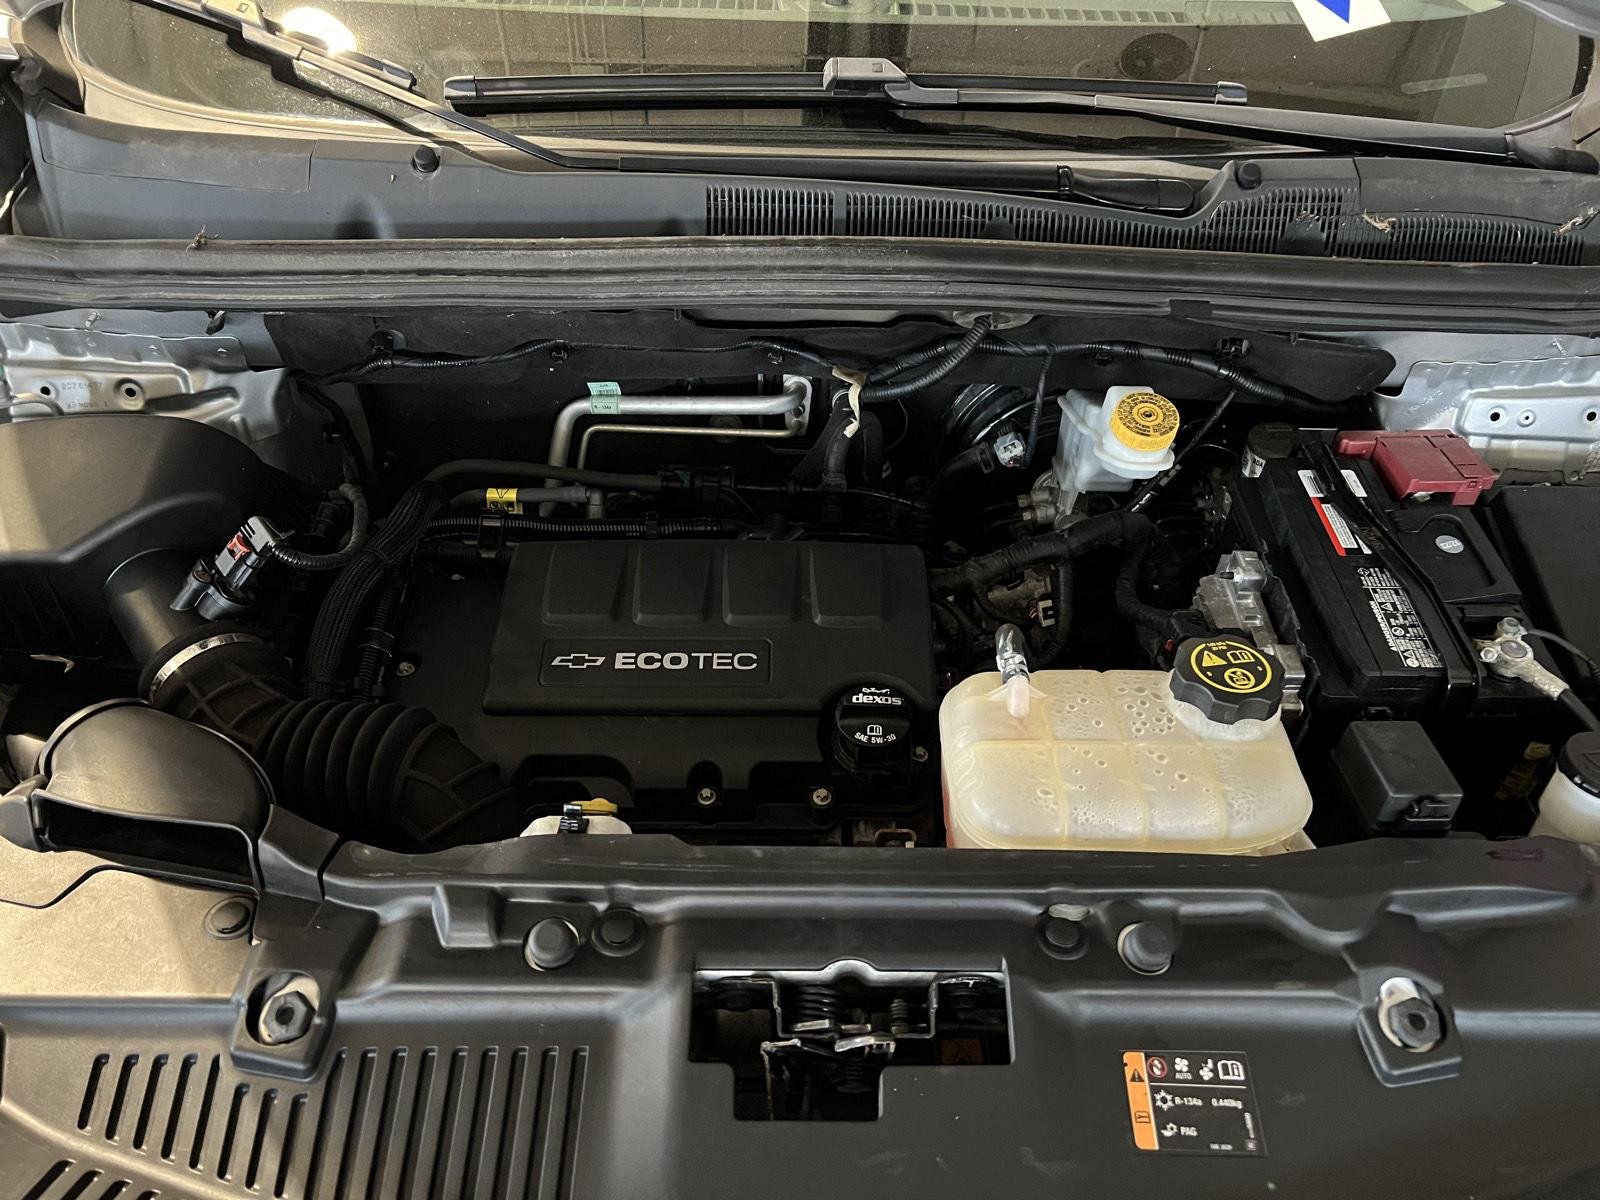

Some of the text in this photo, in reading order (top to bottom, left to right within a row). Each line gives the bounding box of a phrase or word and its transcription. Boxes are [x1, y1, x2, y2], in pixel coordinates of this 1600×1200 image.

[614, 652, 758, 670] ECOTEC
[852, 692, 903, 706] dexos
[854, 731, 896, 744] SAE 5W-30
[1175, 1072, 1192, 1080] AUTO
[1179, 1126, 1198, 1137] PAG
